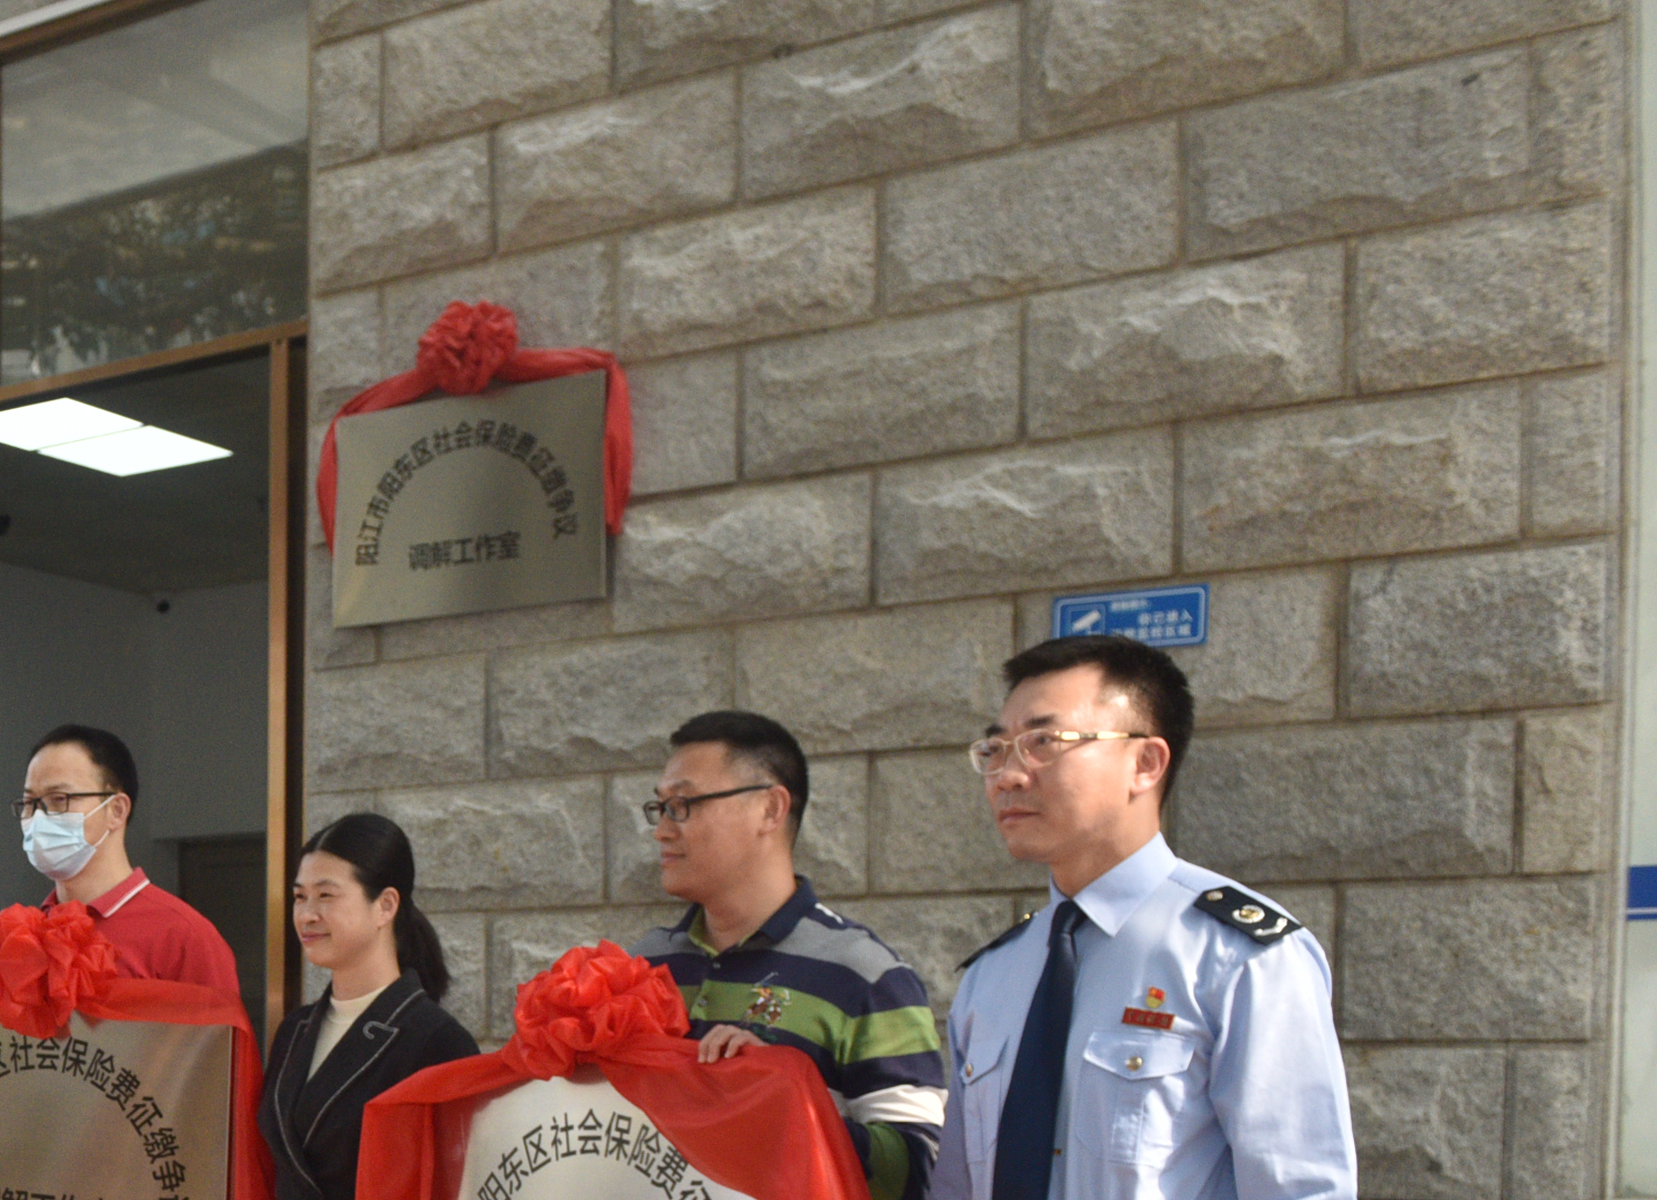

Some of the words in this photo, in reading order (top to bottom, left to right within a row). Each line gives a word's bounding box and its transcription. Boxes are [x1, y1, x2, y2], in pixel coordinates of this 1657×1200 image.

[409, 530, 520, 570] 调解工作室
